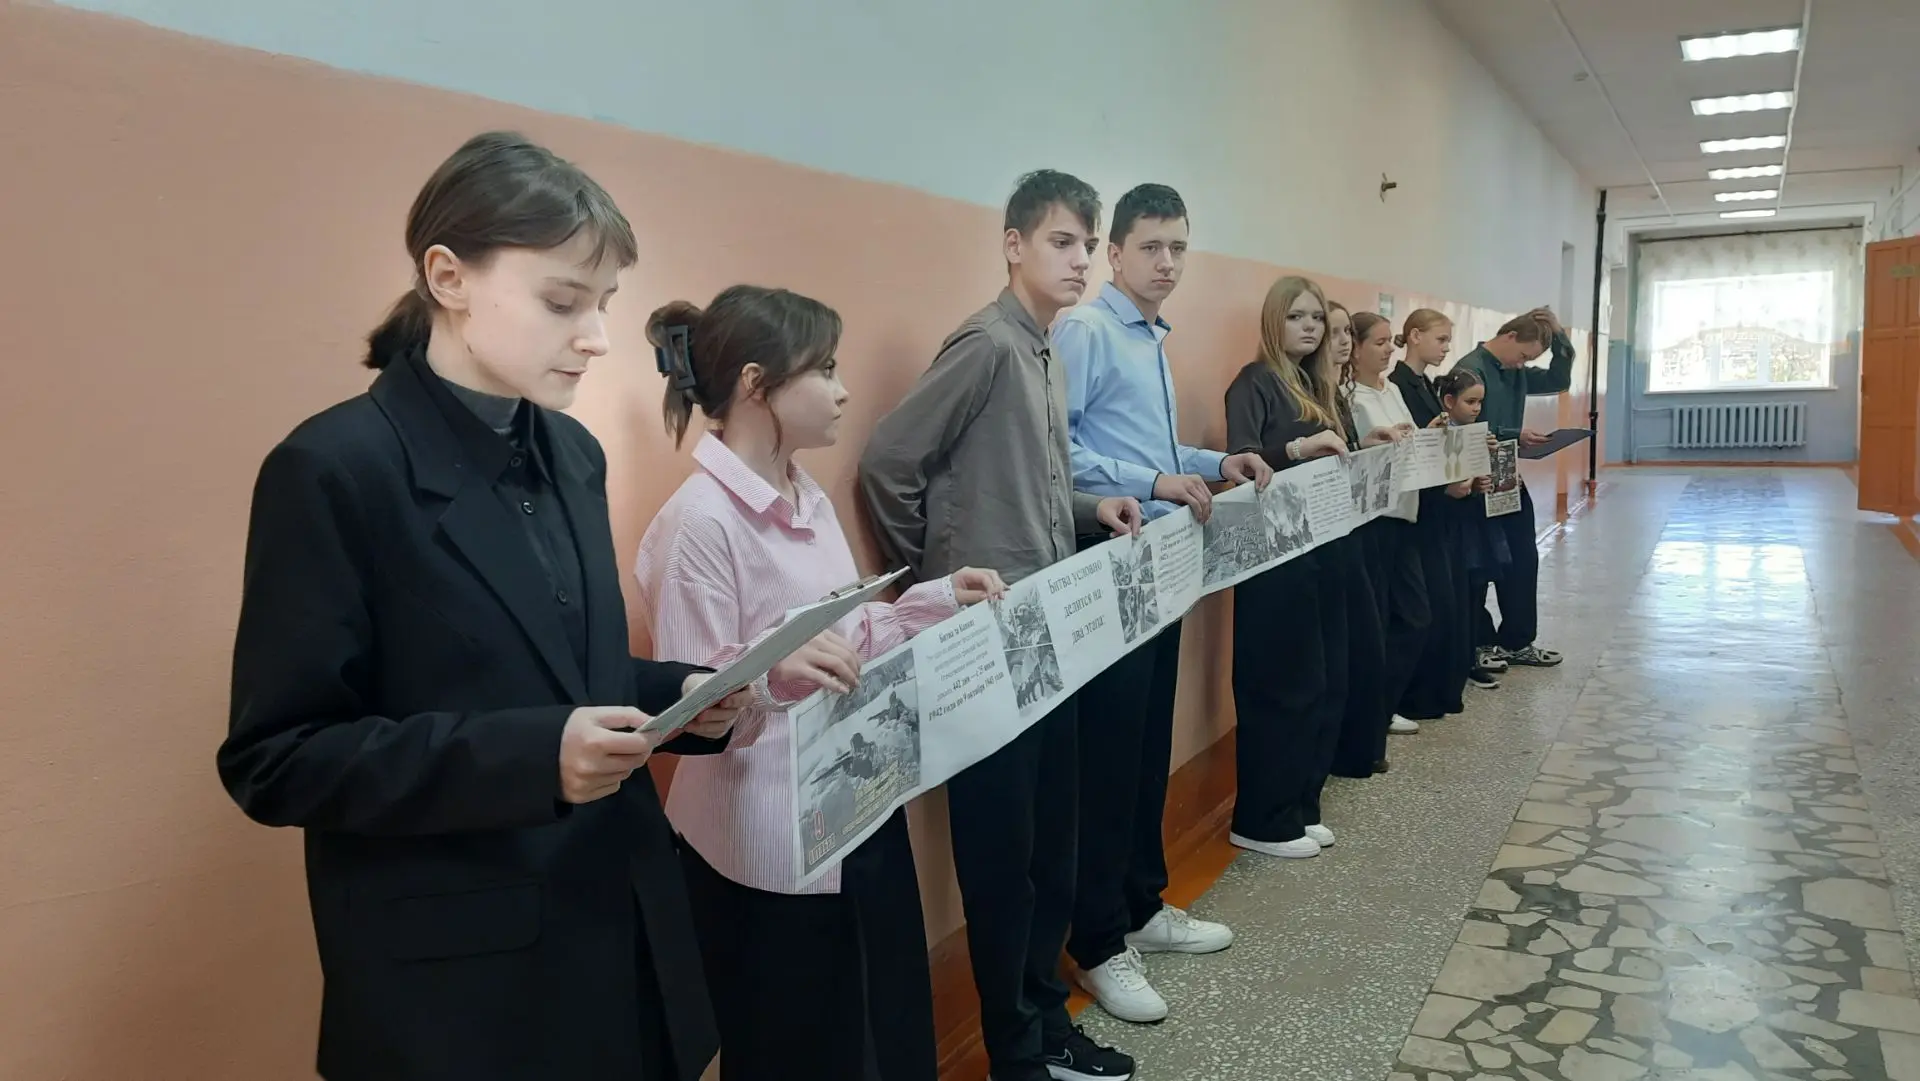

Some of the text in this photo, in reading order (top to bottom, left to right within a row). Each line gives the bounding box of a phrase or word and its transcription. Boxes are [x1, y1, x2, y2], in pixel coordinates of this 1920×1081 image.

[1047, 560, 1103, 594] Битва условно
[1064, 588, 1102, 619] делится на
[1072, 628, 1085, 645] два
